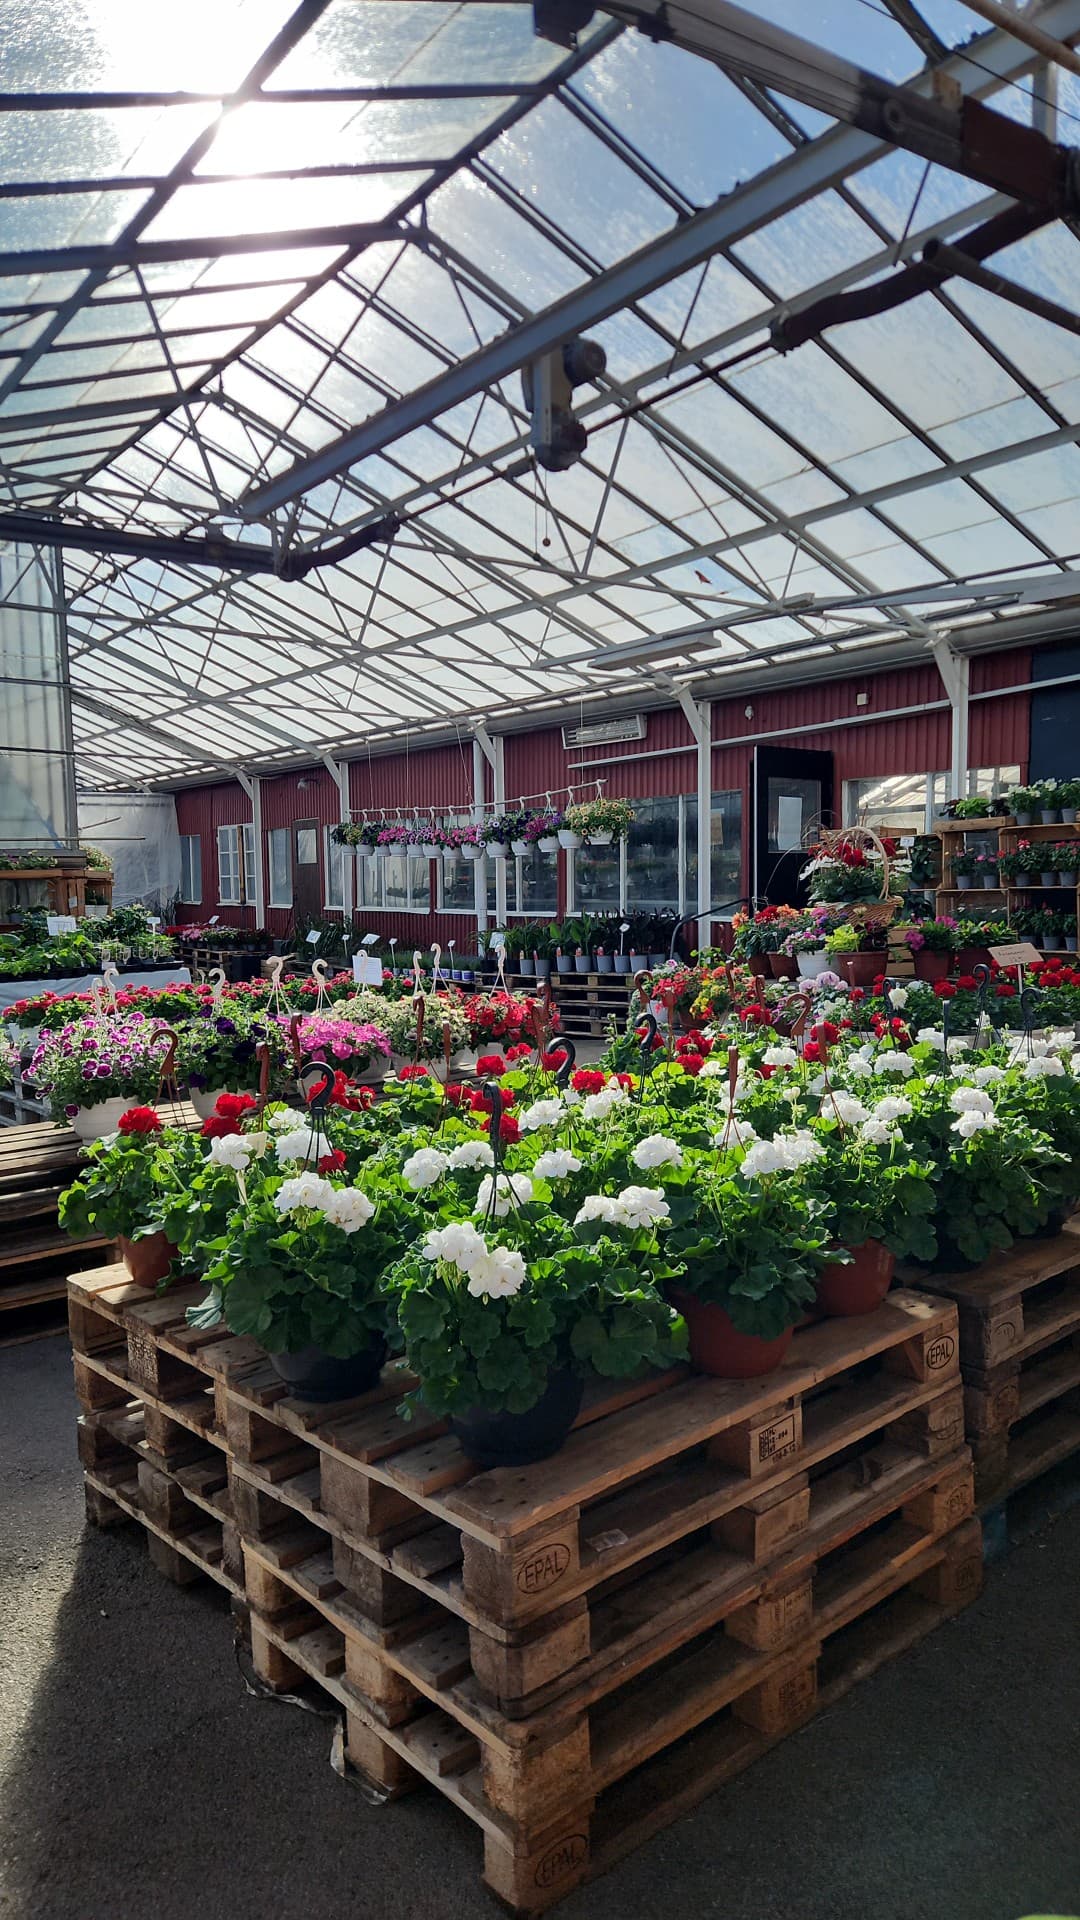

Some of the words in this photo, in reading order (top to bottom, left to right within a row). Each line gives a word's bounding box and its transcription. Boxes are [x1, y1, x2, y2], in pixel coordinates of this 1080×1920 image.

[929, 1339, 951, 1366] EPAL
[523, 1549, 564, 1590] EPAL
[539, 1839, 578, 1882] EPAL
